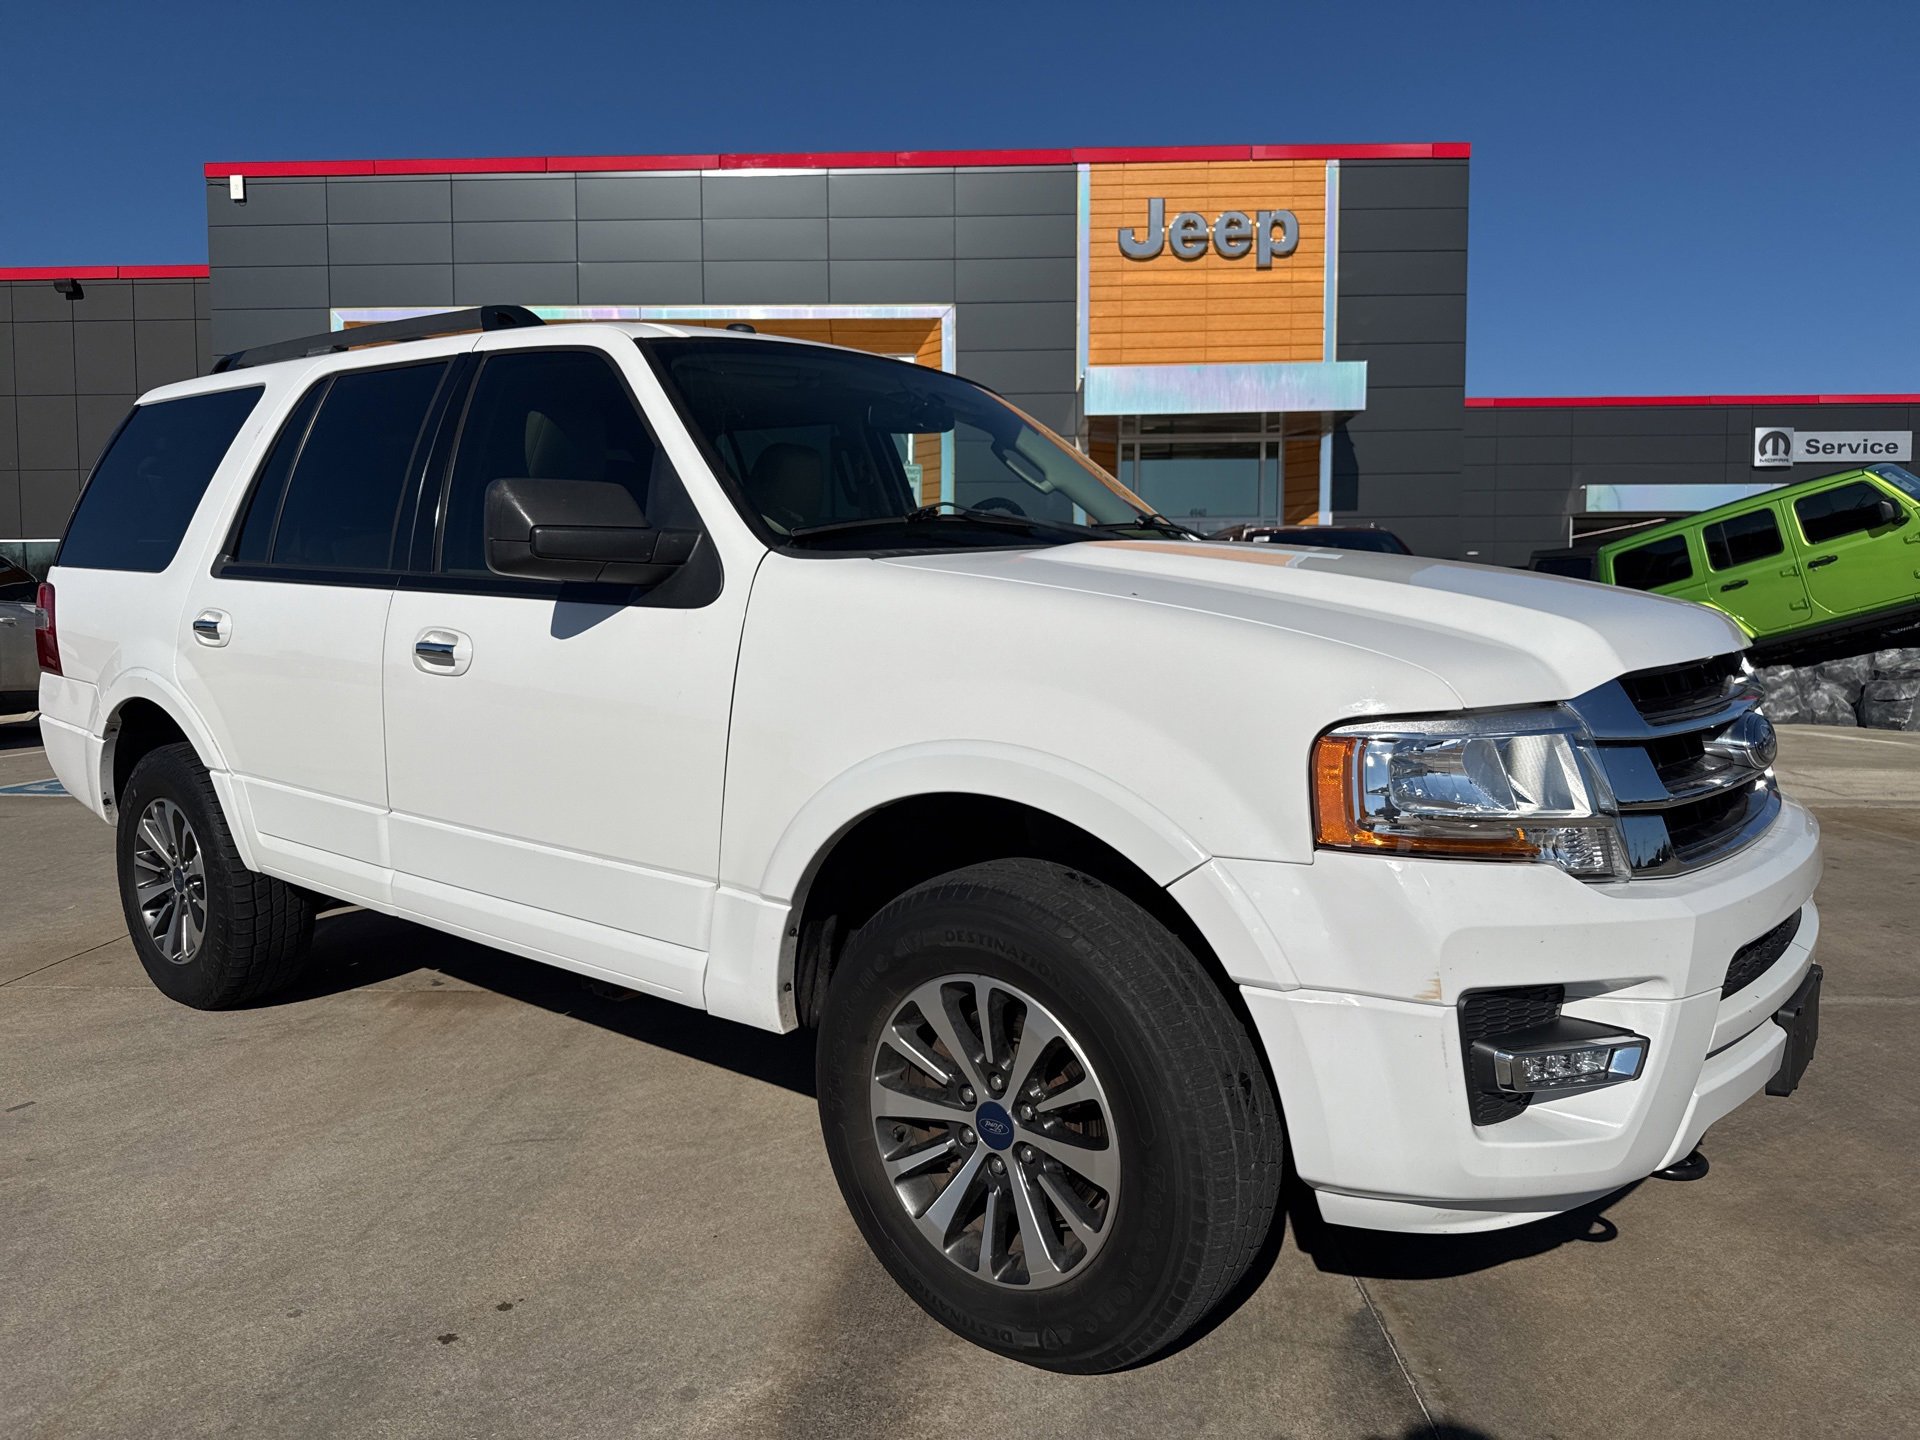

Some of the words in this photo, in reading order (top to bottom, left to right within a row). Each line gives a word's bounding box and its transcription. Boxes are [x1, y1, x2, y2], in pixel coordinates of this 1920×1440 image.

[1117, 198, 1300, 270] Jeep
[1805, 438, 1899, 455] Service
[944, 929, 1064, 986] DESTINATION
[983, 1119, 1006, 1134] Ford
